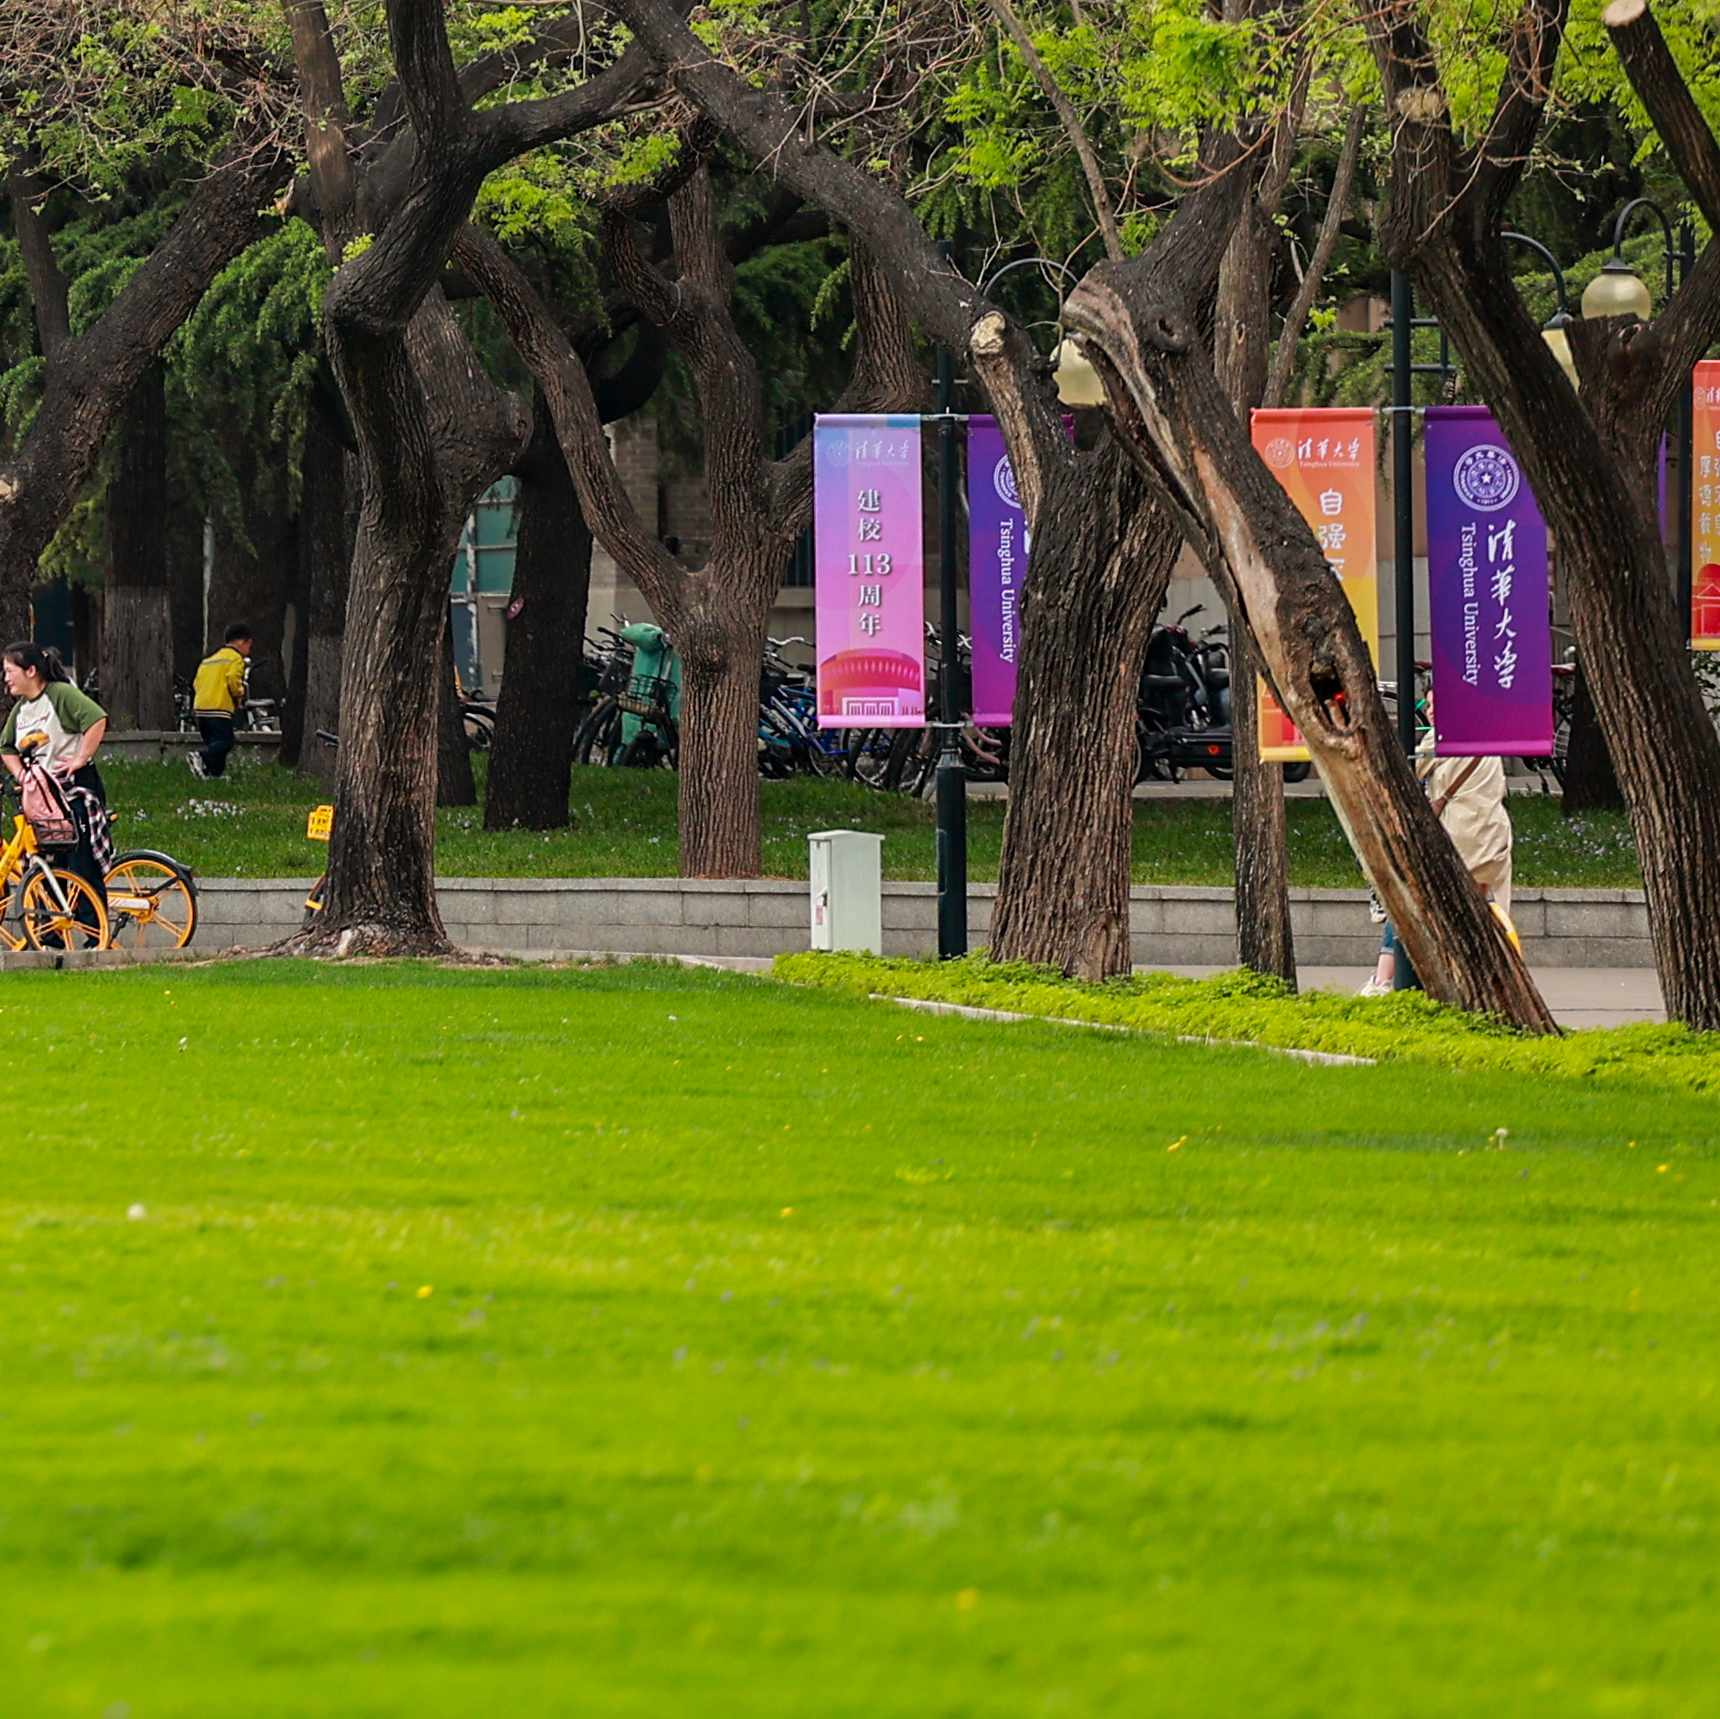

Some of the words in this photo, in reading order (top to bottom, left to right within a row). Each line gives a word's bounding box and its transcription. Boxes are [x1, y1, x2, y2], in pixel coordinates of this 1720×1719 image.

[848, 488, 893, 637] 建校113周年
[997, 518, 1014, 585] Tsinghua
[1459, 522, 1479, 598] Tsinghua
[999, 588, 1016, 663] University
[1462, 602, 1481, 687] University
